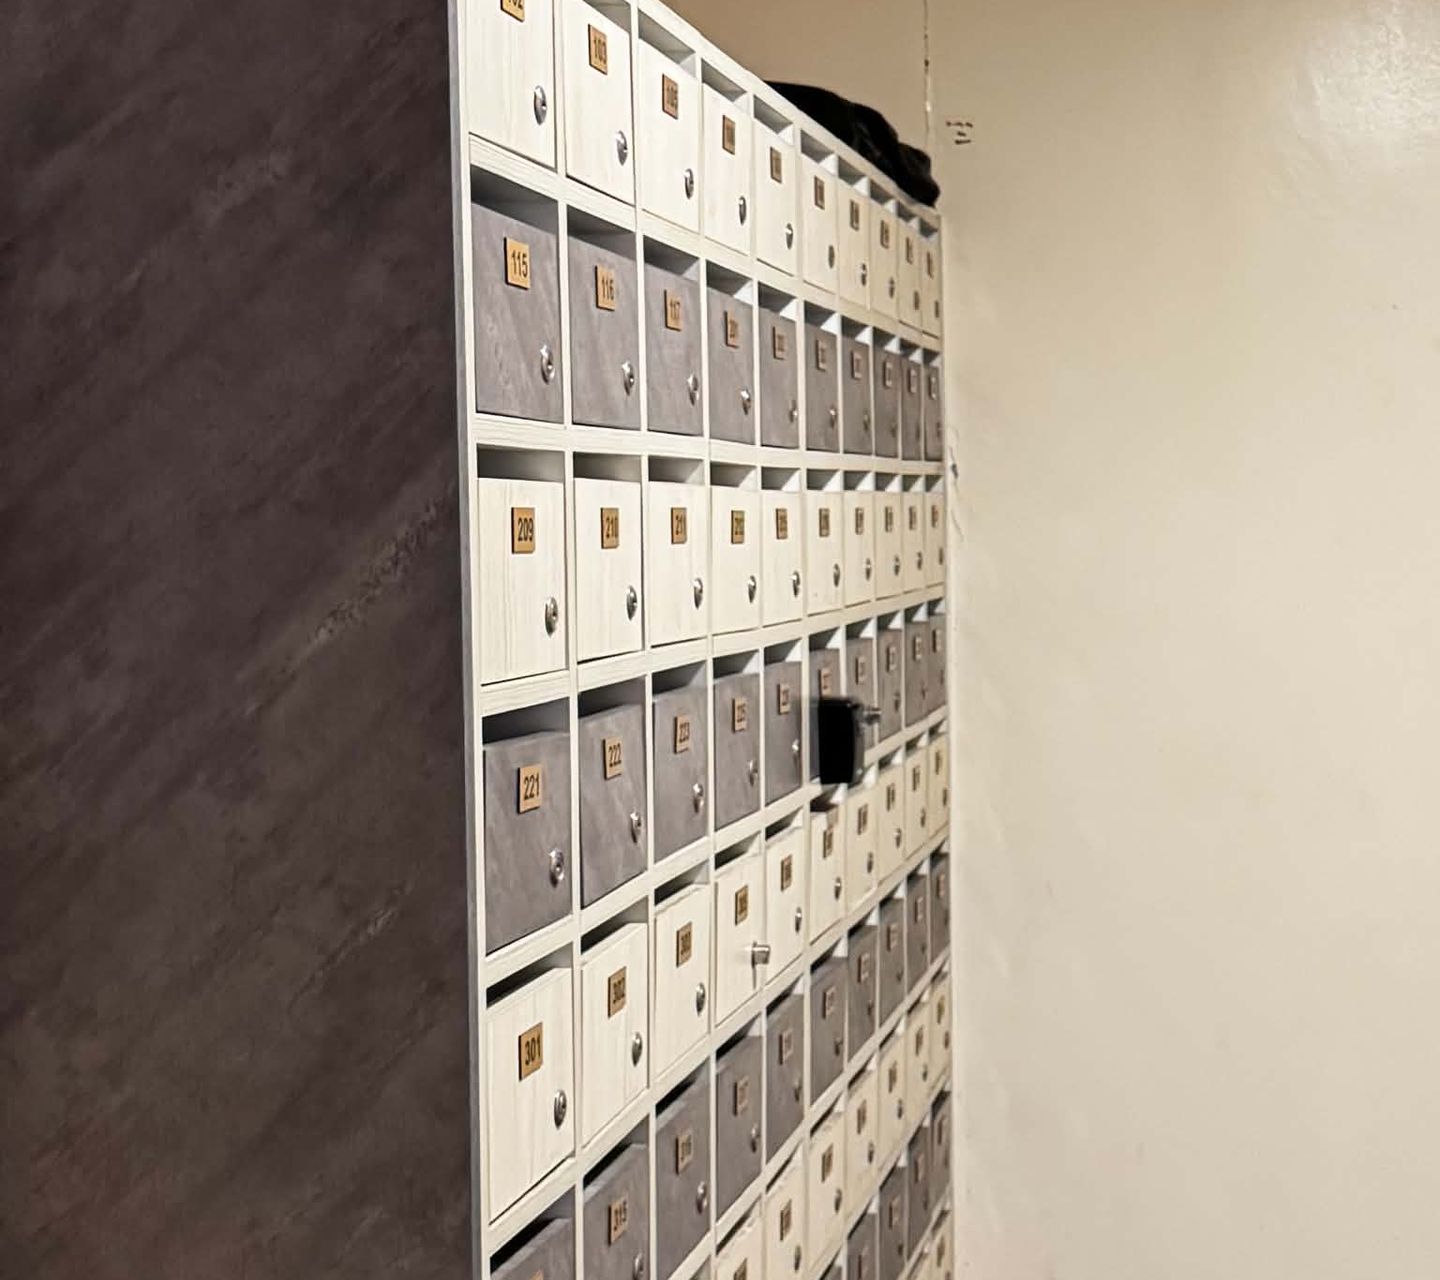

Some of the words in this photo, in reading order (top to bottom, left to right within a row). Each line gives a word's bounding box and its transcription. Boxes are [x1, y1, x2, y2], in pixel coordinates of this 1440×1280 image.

[511, 251, 528, 279] 115
[601, 275, 614, 299] 116
[517, 518, 534, 542] 209
[608, 745, 621, 768] 222
[524, 776, 540, 801] 221
[524, 1035, 542, 1066] 301
